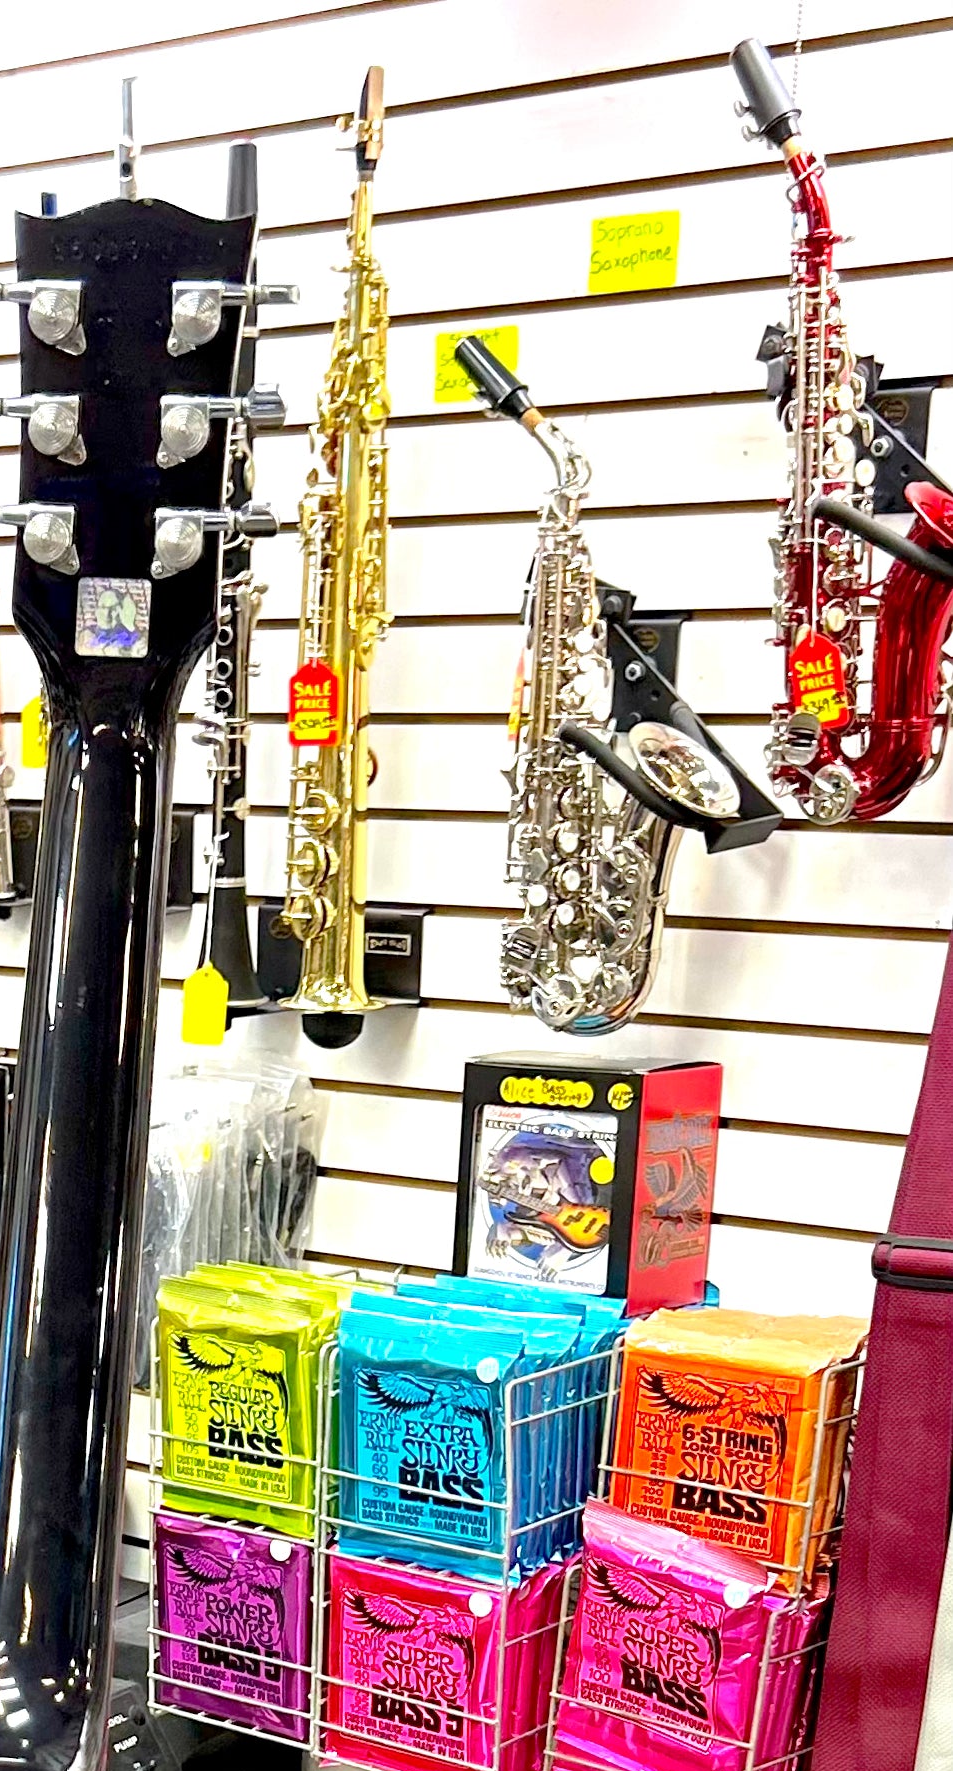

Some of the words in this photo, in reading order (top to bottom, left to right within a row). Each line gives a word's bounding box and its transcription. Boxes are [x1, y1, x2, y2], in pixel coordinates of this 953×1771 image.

[595, 220, 664, 247] Soprano
[590, 246, 673, 274] Saxophone
[794, 653, 835, 678] SALE
[294, 680, 331, 697] SALE
[799, 673, 835, 691] PRICE
[295, 698, 330, 710] PRICE
[485, 1119, 540, 1134] ELECTRIC
[543, 1127, 574, 1139] BASS
[209, 1380, 279, 1410] REGULAR
[208, 1425, 284, 1469] BASS
[404, 1419, 482, 1450] EXTRA
[682, 1423, 774, 1454] 6-STRING
[372, 1453, 388, 1465] 40
[681, 1441, 721, 1456] LONG
[725, 1448, 772, 1465] SCALE
[372, 1464, 388, 1475] 60
[372, 1486, 388, 1498] 95
[399, 1465, 484, 1513] BASS
[641, 1486, 664, 1497] 100
[361, 1500, 396, 1513] CUSTOM
[429, 1508, 488, 1527] ROUNDWOUND
[673, 1483, 770, 1524] BASS
[361, 1509, 383, 1522] BASS
[385, 1512, 419, 1528] STRINGS
[435, 1520, 458, 1534] MADE
[460, 1524, 470, 1536] IN
[471, 1525, 488, 1539] USA
[631, 1503, 667, 1519] CUSTOM
[705, 1516, 769, 1538] ROUNDWOUND
[709, 1529, 734, 1544] MADE
[737, 1535, 746, 1547] IN
[749, 1537, 767, 1551] USA
[205, 1591, 275, 1625] POWER
[625, 1618, 706, 1667] SUPER
[197, 1632, 261, 1677] BASS
[265, 1650, 281, 1682] 5
[386, 1640, 461, 1676] SUPER
[589, 1668, 611, 1684] 100
[621, 1660, 709, 1720] BASS
[371, 1684, 441, 1733] BASS
[446, 1698, 464, 1738] 5
[113, 1735, 138, 1753] PUMP
[413, 1739, 437, 1754] MADE
